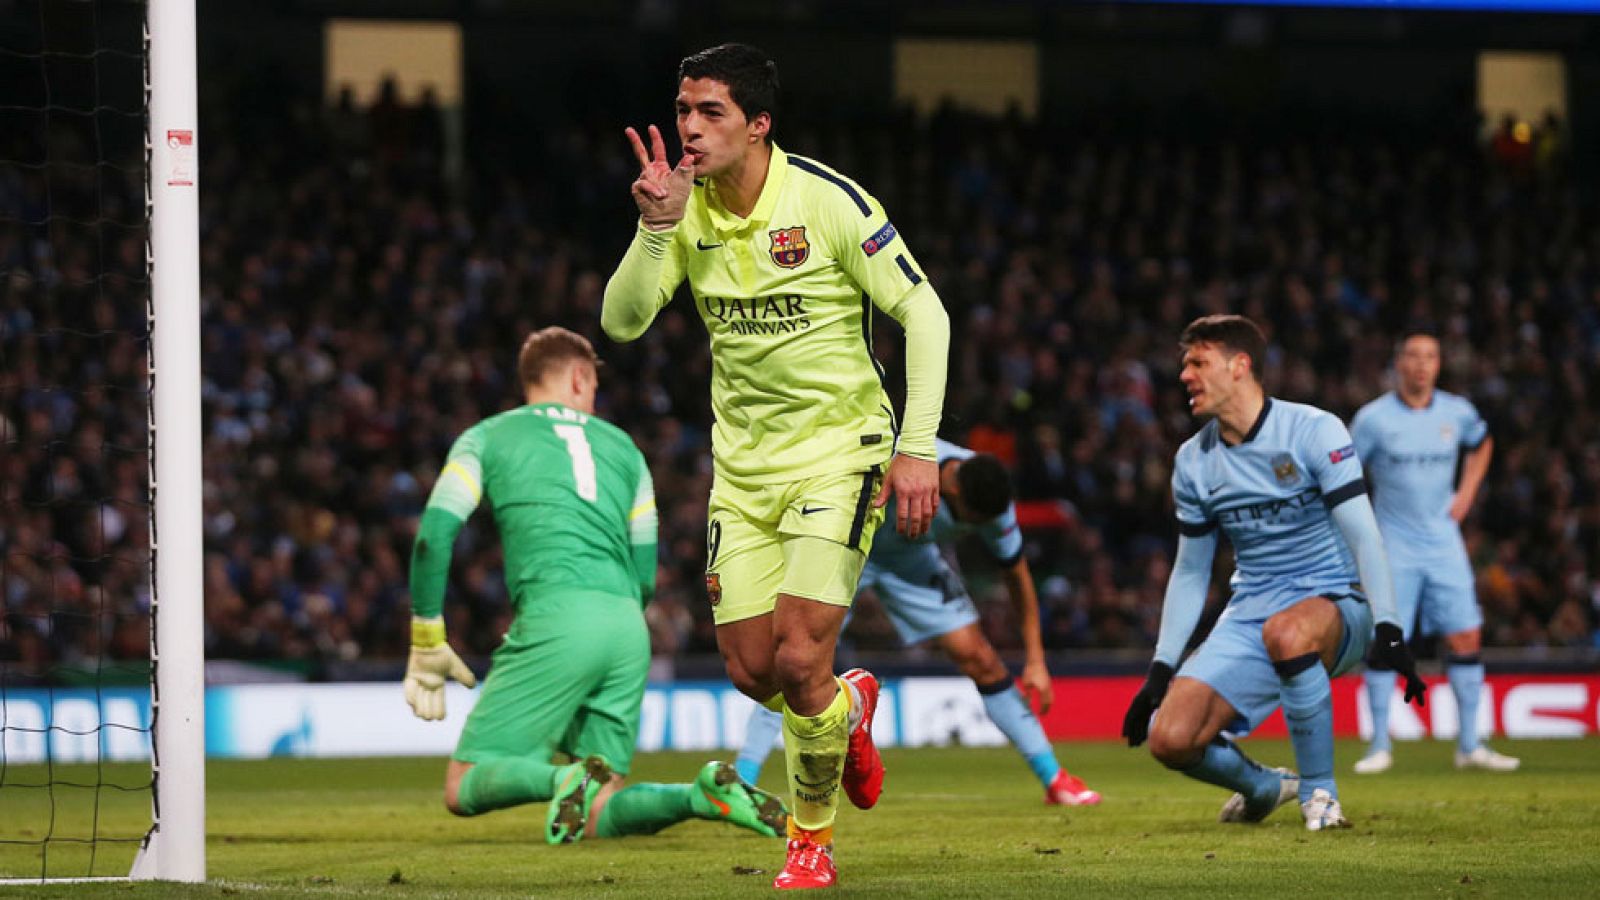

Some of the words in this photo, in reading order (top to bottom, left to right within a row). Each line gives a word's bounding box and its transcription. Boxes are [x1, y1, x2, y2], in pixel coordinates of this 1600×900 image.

[704, 293, 808, 323] QATAR
[730, 318, 811, 335] AIRWAYS
[553, 424, 597, 502] 1
